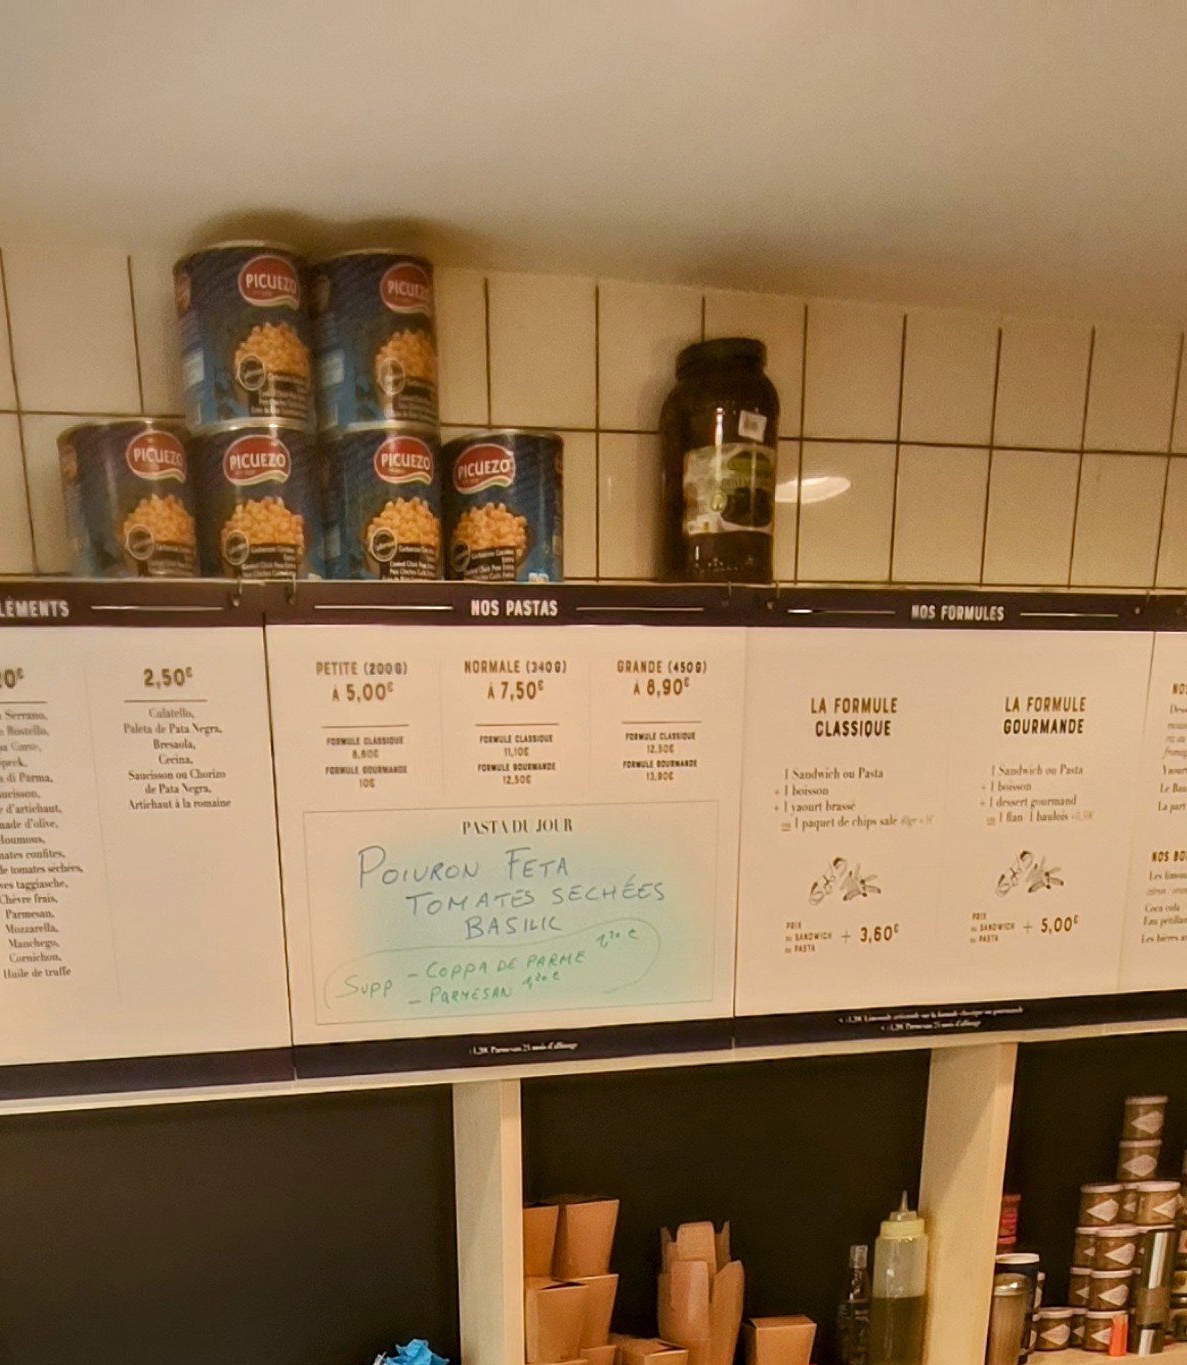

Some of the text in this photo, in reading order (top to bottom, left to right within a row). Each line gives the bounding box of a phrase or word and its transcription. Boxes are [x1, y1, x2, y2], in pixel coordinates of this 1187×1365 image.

[245, 274, 297, 294] PICUEZO
[134, 449, 183, 466] PICUEZO
[230, 454, 286, 471] PICUEZO
[381, 453, 430, 470] PICUEZO
[458, 457, 510, 478] PICUEZO
[471, 600, 558, 616] NOS PASTAS
[912, 604, 1005, 621] NOS FORMULES
[316, 661, 407, 675] PETITE (200G)
[464, 660, 567, 674] NORMALE (340G)
[617, 660, 707, 674] GRANDE (450G)
[144, 667, 193, 689] 2,50€
[500, 680, 544, 702] 7,50€
[646, 677, 689, 698] 8,90€
[811, 697, 898, 714] LA FORMULE
[1005, 696, 1087, 712] LA FORMULE
[124, 723, 152, 734] Paleta
[169, 723, 189, 734] Pata
[192, 723, 222, 737] Negra,
[815, 720, 891, 738] CLASSIQUE
[1003, 718, 1084, 735] GOURMANDE
[153, 738, 196, 750] Bresaola,
[128, 768, 226, 780] Saucisson ou Chorizo
[145, 783, 212, 796] de Pata Negra,
[129, 798, 172, 810] Artichaut
[182, 797, 191, 808] la
[193, 798, 231, 808] romaine
[462, 817, 574, 835] PASTA DU JOUR
[505, 847, 569, 881] FETA
[406, 890, 535, 917] TOMATES
[5, 908, 55, 920] Parmesan,
[5, 922, 59, 934] Mozzarella,
[464, 915, 563, 940] BASILIC
[9, 938, 60, 950] Manchego,
[426, 960, 490, 980] COPPA
[526, 950, 586, 967] PARME
